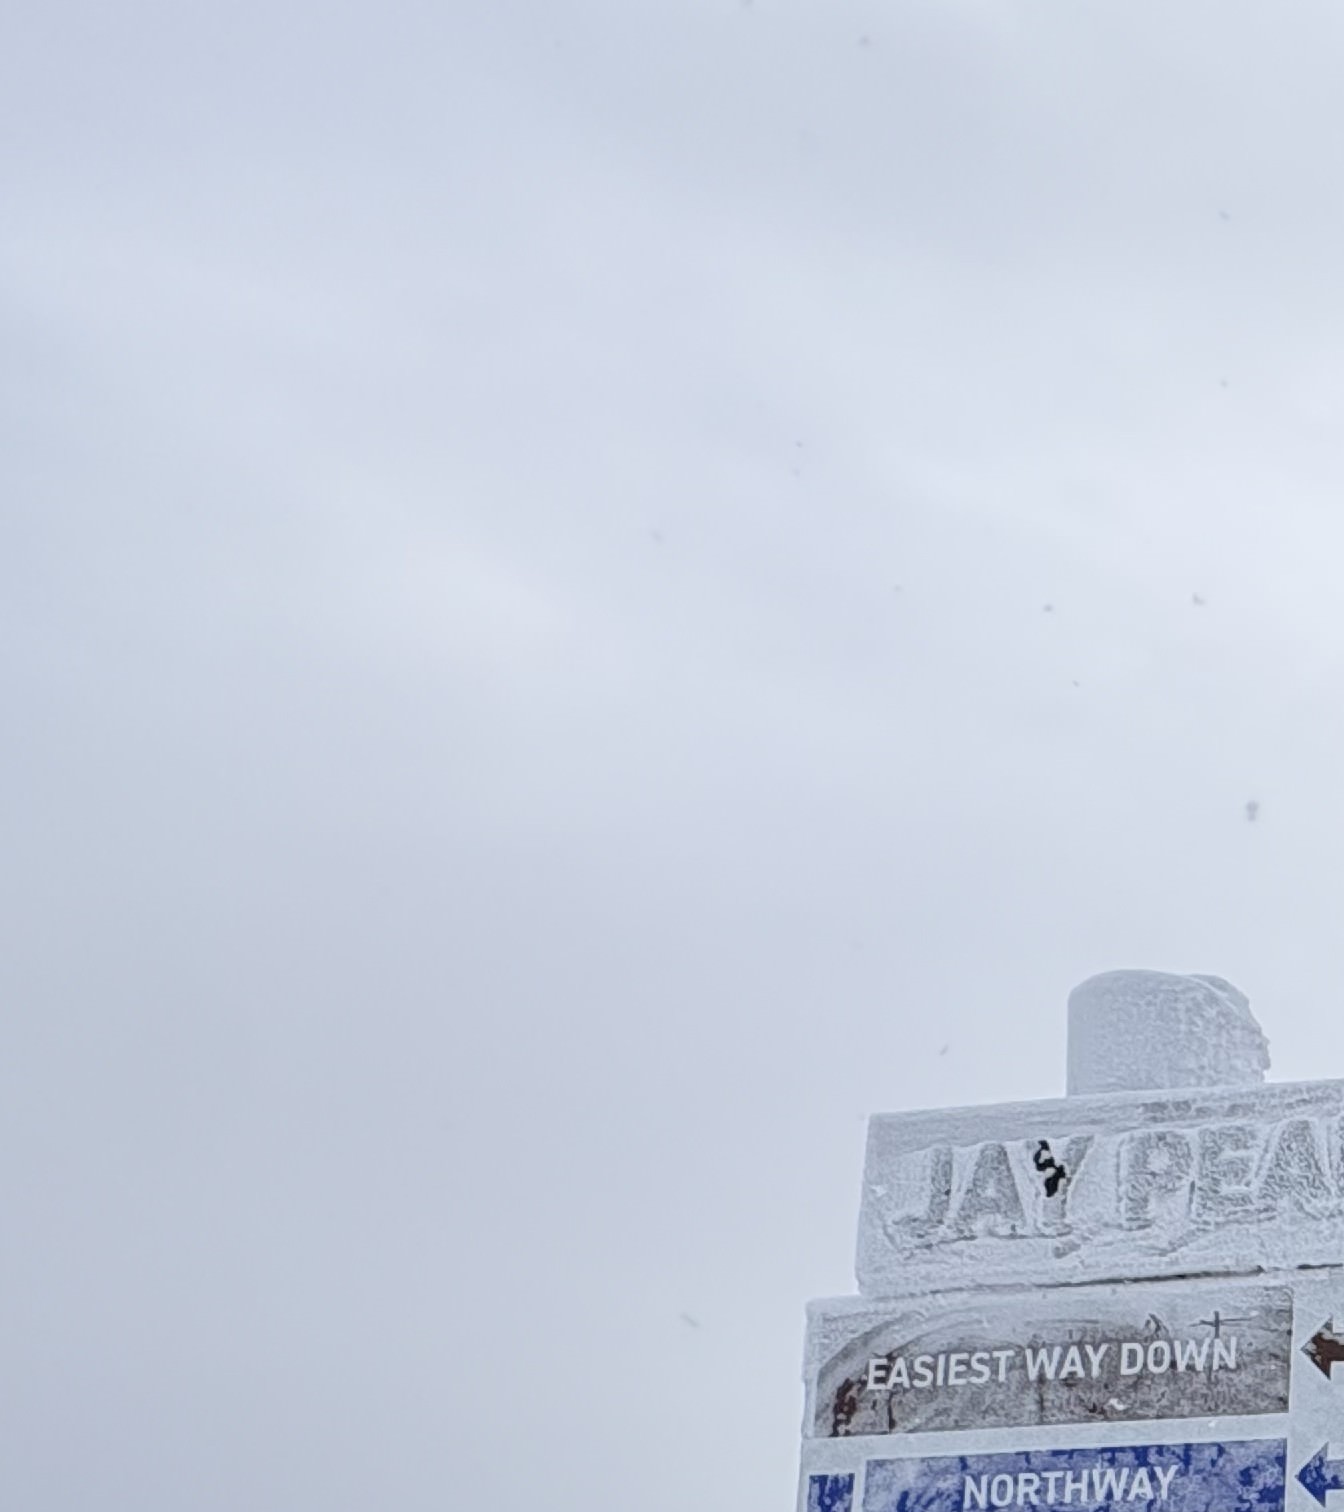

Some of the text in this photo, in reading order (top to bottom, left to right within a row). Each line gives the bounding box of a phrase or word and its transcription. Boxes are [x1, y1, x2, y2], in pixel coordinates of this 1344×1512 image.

[897, 1133, 1095, 1238] JAY
[867, 1337, 1238, 1391] EASIEST WAY DOWN
[963, 1466, 1179, 1510] NORTHWAY
